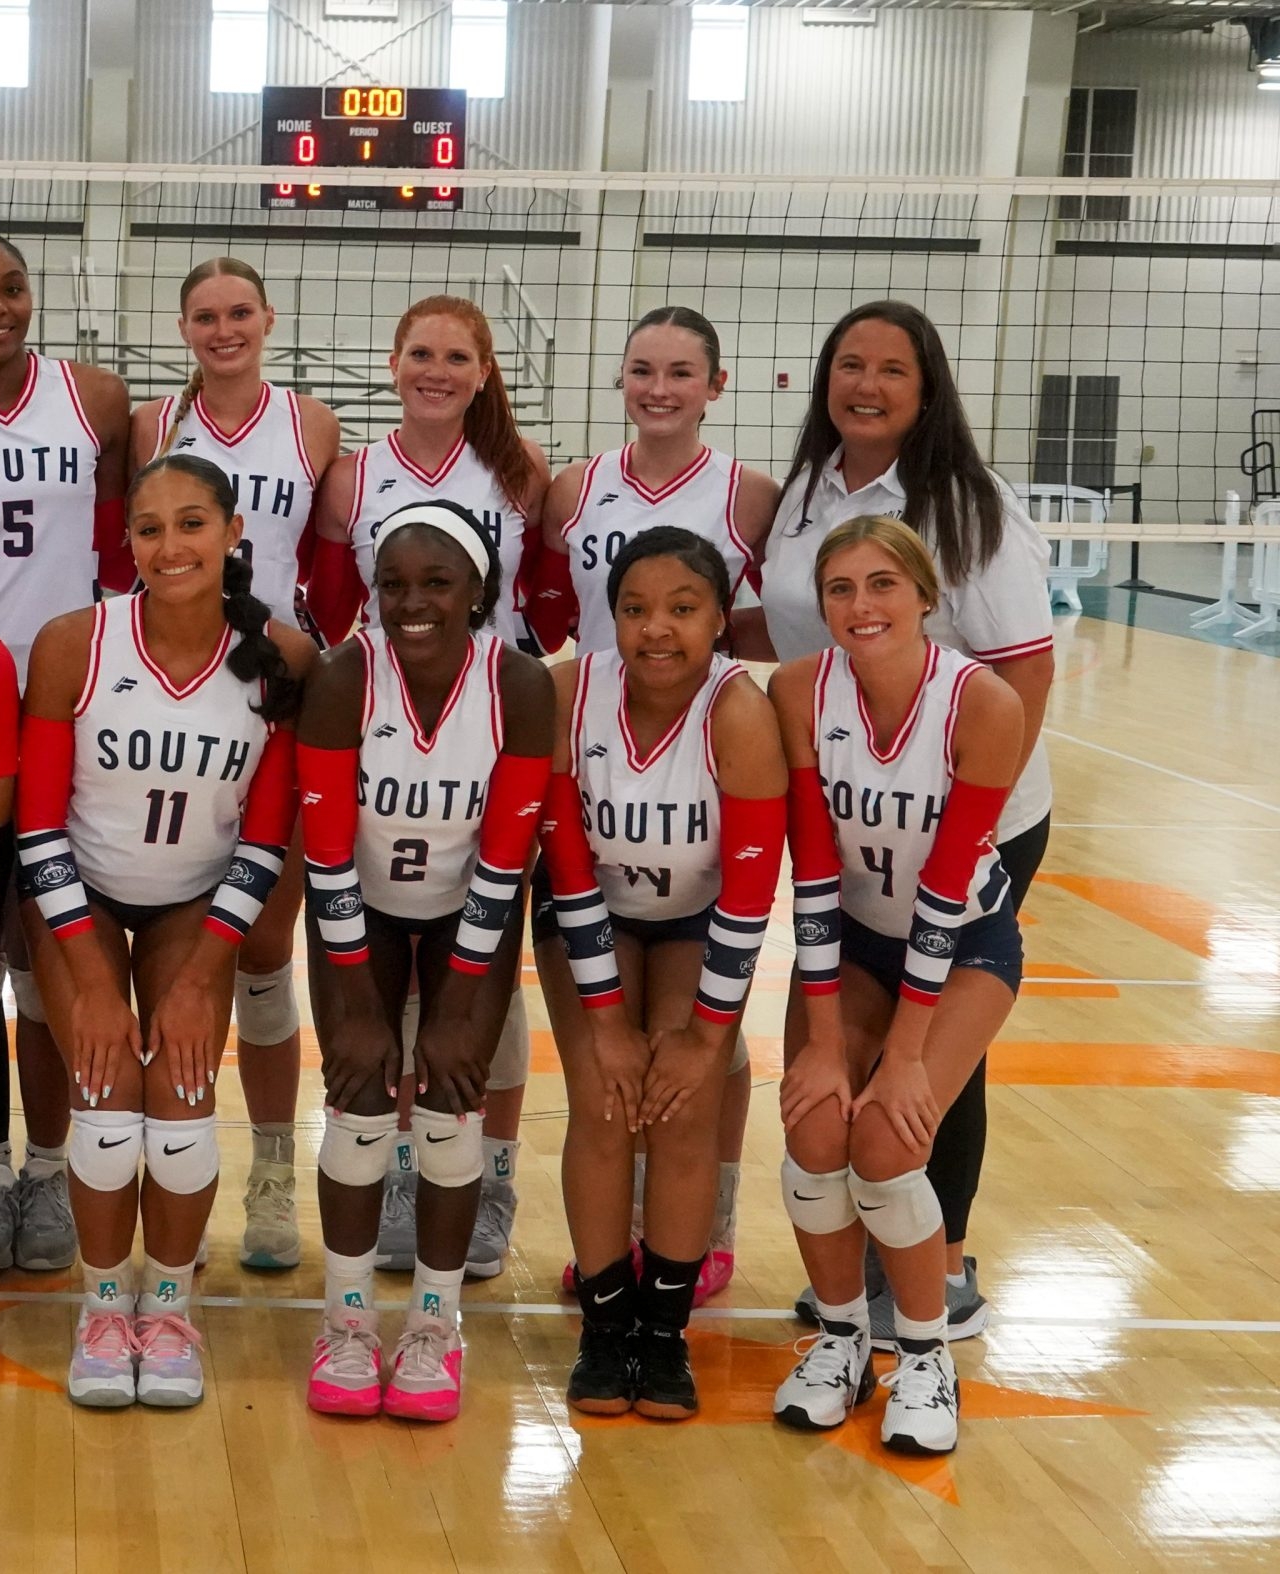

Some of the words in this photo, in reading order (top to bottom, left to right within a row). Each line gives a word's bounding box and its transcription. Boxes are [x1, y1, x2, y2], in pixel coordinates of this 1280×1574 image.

[344, 89, 402, 116] 0:00
[277, 120, 312, 133] HOME
[349, 127, 379, 136] PERIOD
[413, 122, 453, 134] GUEST
[299, 136, 314, 162] 0
[437, 138, 452, 163] 0
[348, 200, 376, 209] MATCH
[427, 201, 454, 209] SCORE
[2, 499, 33, 557] 5
[97, 729, 250, 782] SOUTH
[358, 767, 487, 820] SOUTH
[144, 789, 188, 845] 11
[581, 789, 708, 845] SOUTH
[390, 839, 429, 882] 2
[860, 846, 893, 898] 4
